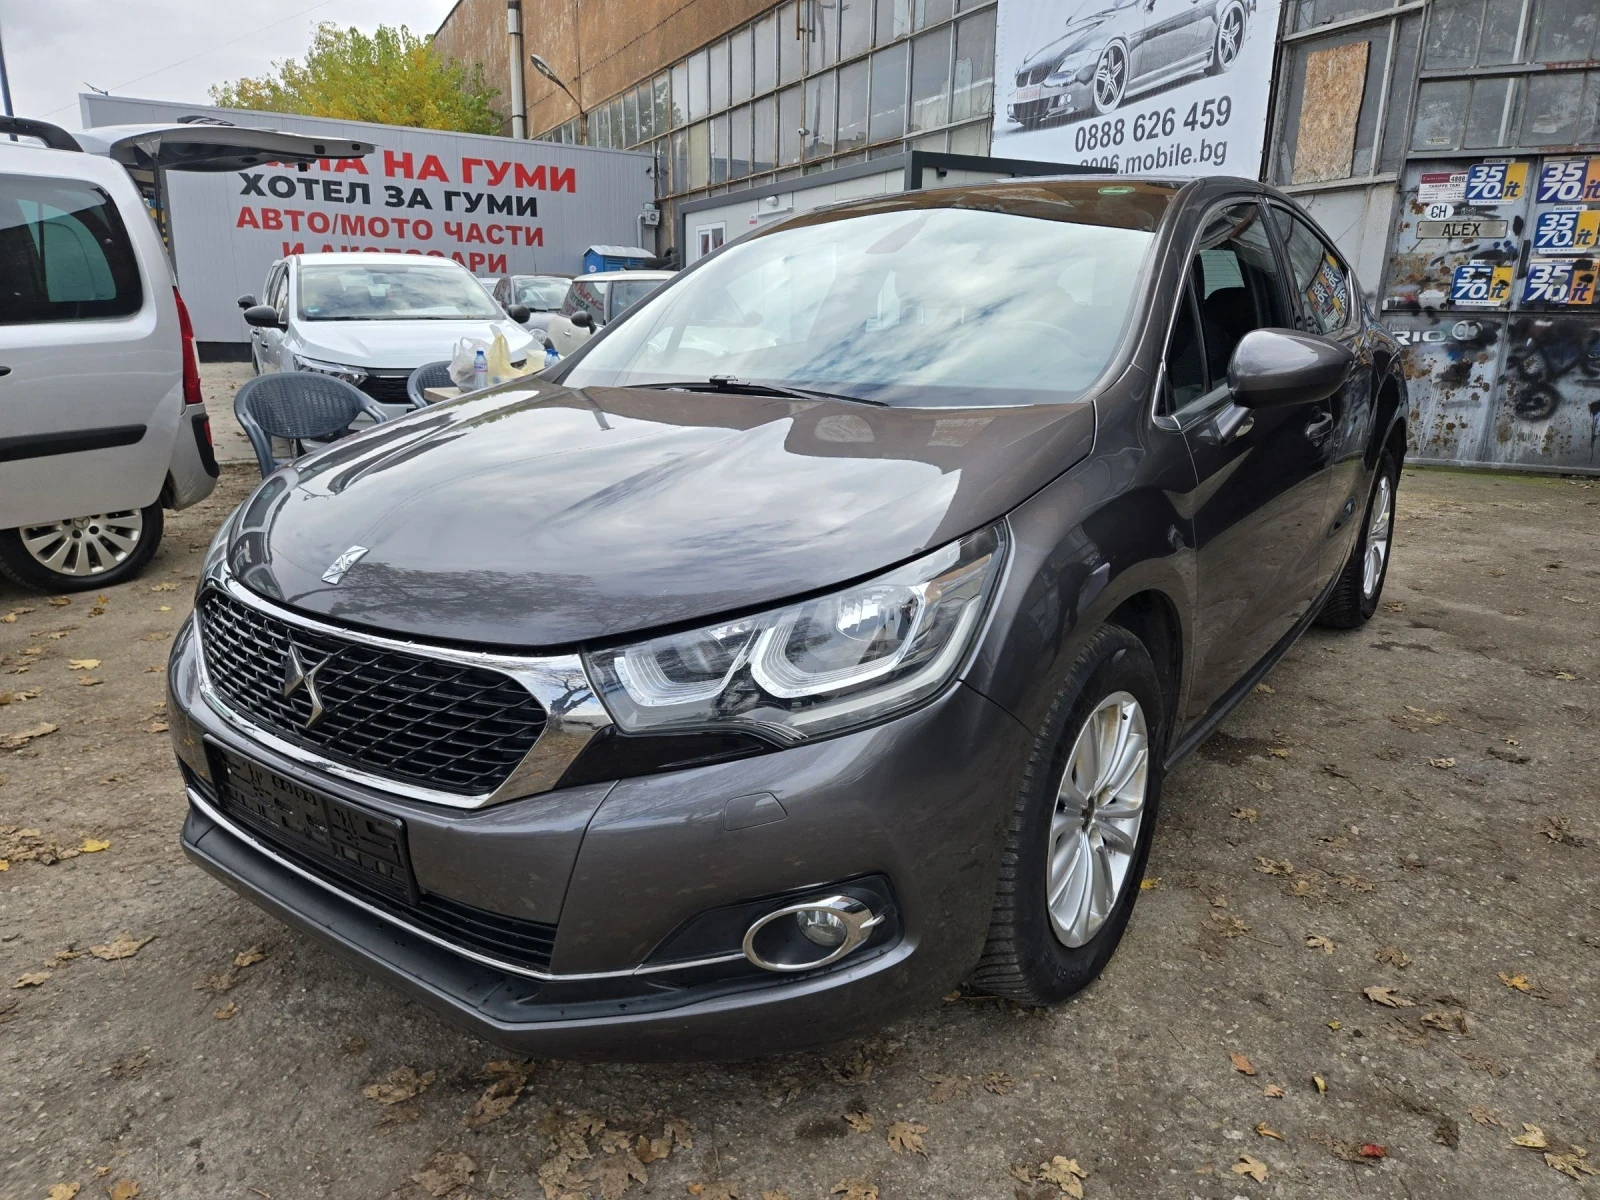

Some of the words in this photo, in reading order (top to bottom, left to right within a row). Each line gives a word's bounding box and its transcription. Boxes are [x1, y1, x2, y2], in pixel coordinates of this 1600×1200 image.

[1074, 117, 1126, 153] 0888
[1132, 107, 1176, 142] 626
[1183, 95, 1232, 132] 459
[383, 150, 450, 182] НА
[461, 157, 577, 194] ГУМИ
[1469, 165, 1506, 182] 35
[1543, 162, 1586, 182] 35
[238, 172, 371, 205] ХОТЕЛ
[384, 185, 434, 210] ЗА
[444, 190, 538, 217] ГУМИ
[236, 206, 433, 241] АВТО/МОТО
[444, 221, 544, 247] ЧАСТИ
[1441, 222, 1482, 237] ALEX
[1539, 213, 1577, 231] 35
[1530, 265, 1573, 283] 35
[1391, 331, 1447, 346] RIO
